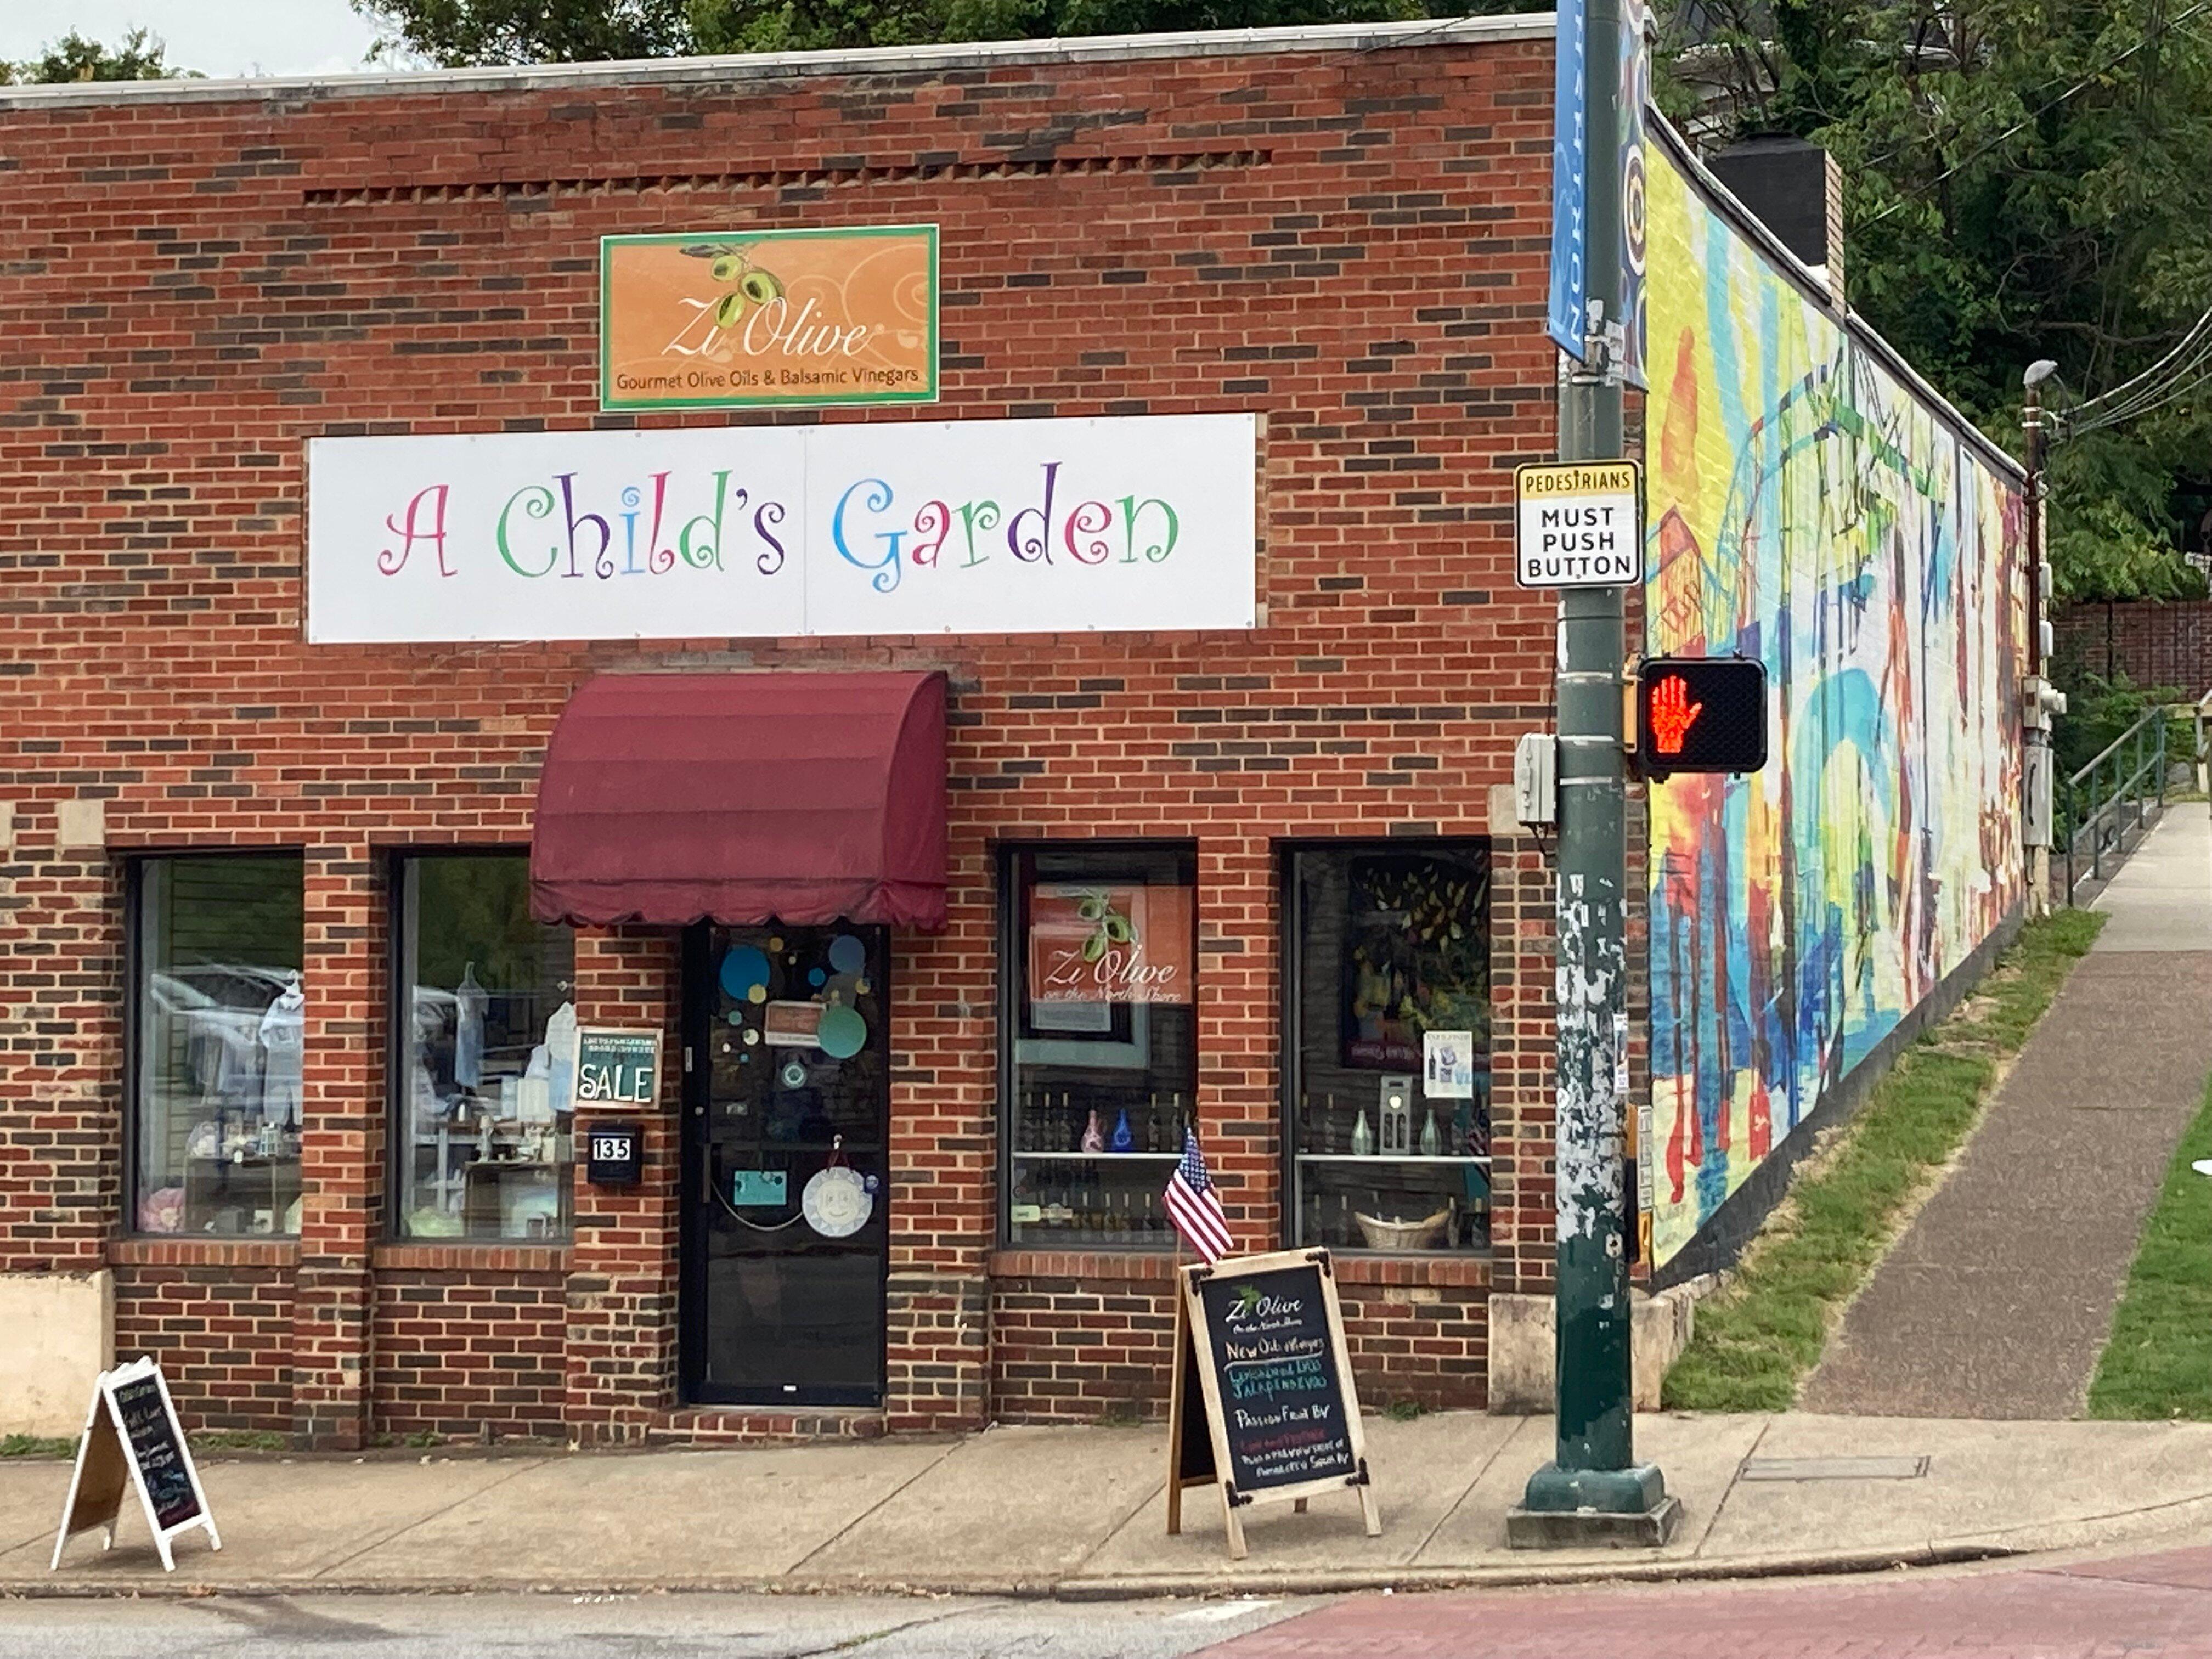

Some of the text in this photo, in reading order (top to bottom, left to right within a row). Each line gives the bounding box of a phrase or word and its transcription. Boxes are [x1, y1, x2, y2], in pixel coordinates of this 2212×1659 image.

[743, 296, 870, 357] Olive
[617, 366, 919, 390] Gourmet Olive Oils & Balsamic Vinegars
[1526, 470, 1630, 493] PEDESTRIANS
[377, 461, 1179, 593] A Child's Garden
[1541, 507, 1615, 528] MUST
[1543, 531, 1615, 552] PUSH
[1527, 556, 1630, 578] BUTTON
[1093, 944, 1179, 984] Olive
[579, 1063, 653, 1103] SALE
[594, 1139, 628, 1159] 135
[1256, 1294, 1304, 1317] Olive
